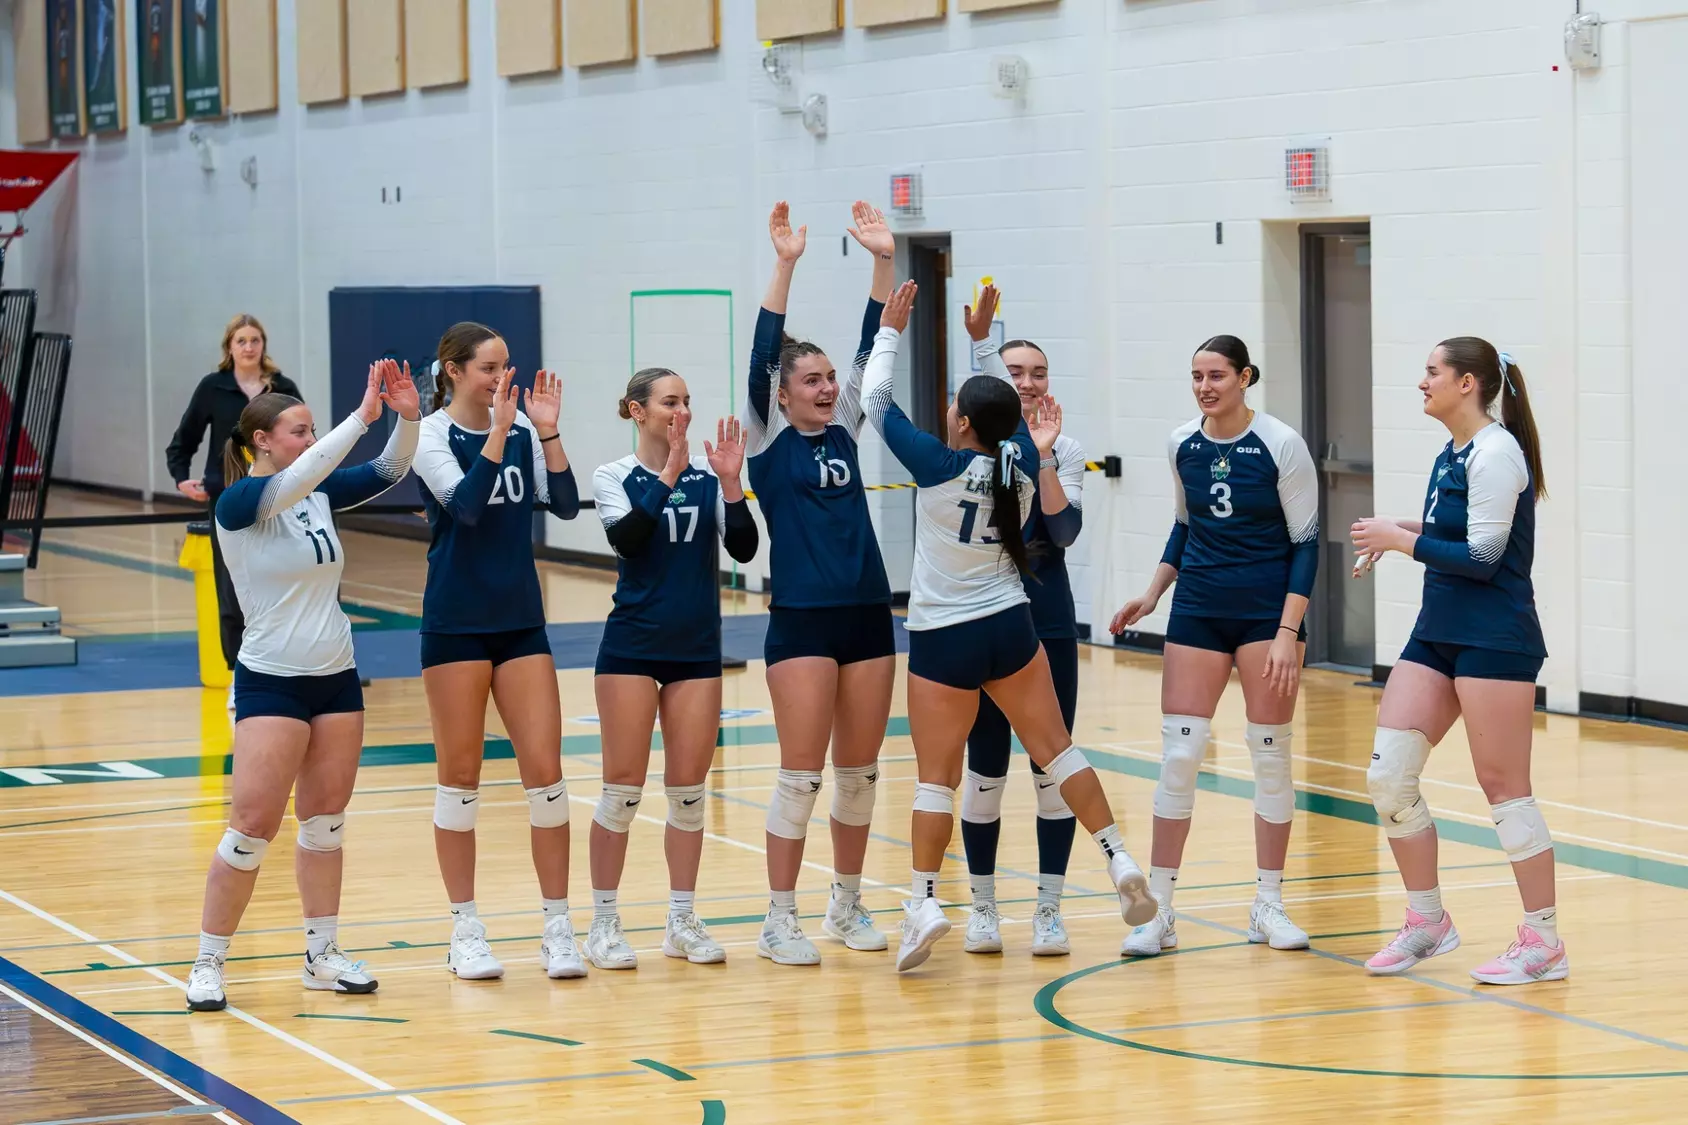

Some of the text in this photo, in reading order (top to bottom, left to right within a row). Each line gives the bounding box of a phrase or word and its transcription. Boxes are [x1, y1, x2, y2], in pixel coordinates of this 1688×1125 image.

[1236, 446, 1261, 454] OUA
[487, 465, 524, 505] 20
[1209, 482, 1233, 518] 3
[1425, 486, 1439, 524] 2
[662, 506, 699, 543] 17
[305, 528, 336, 565] 11
